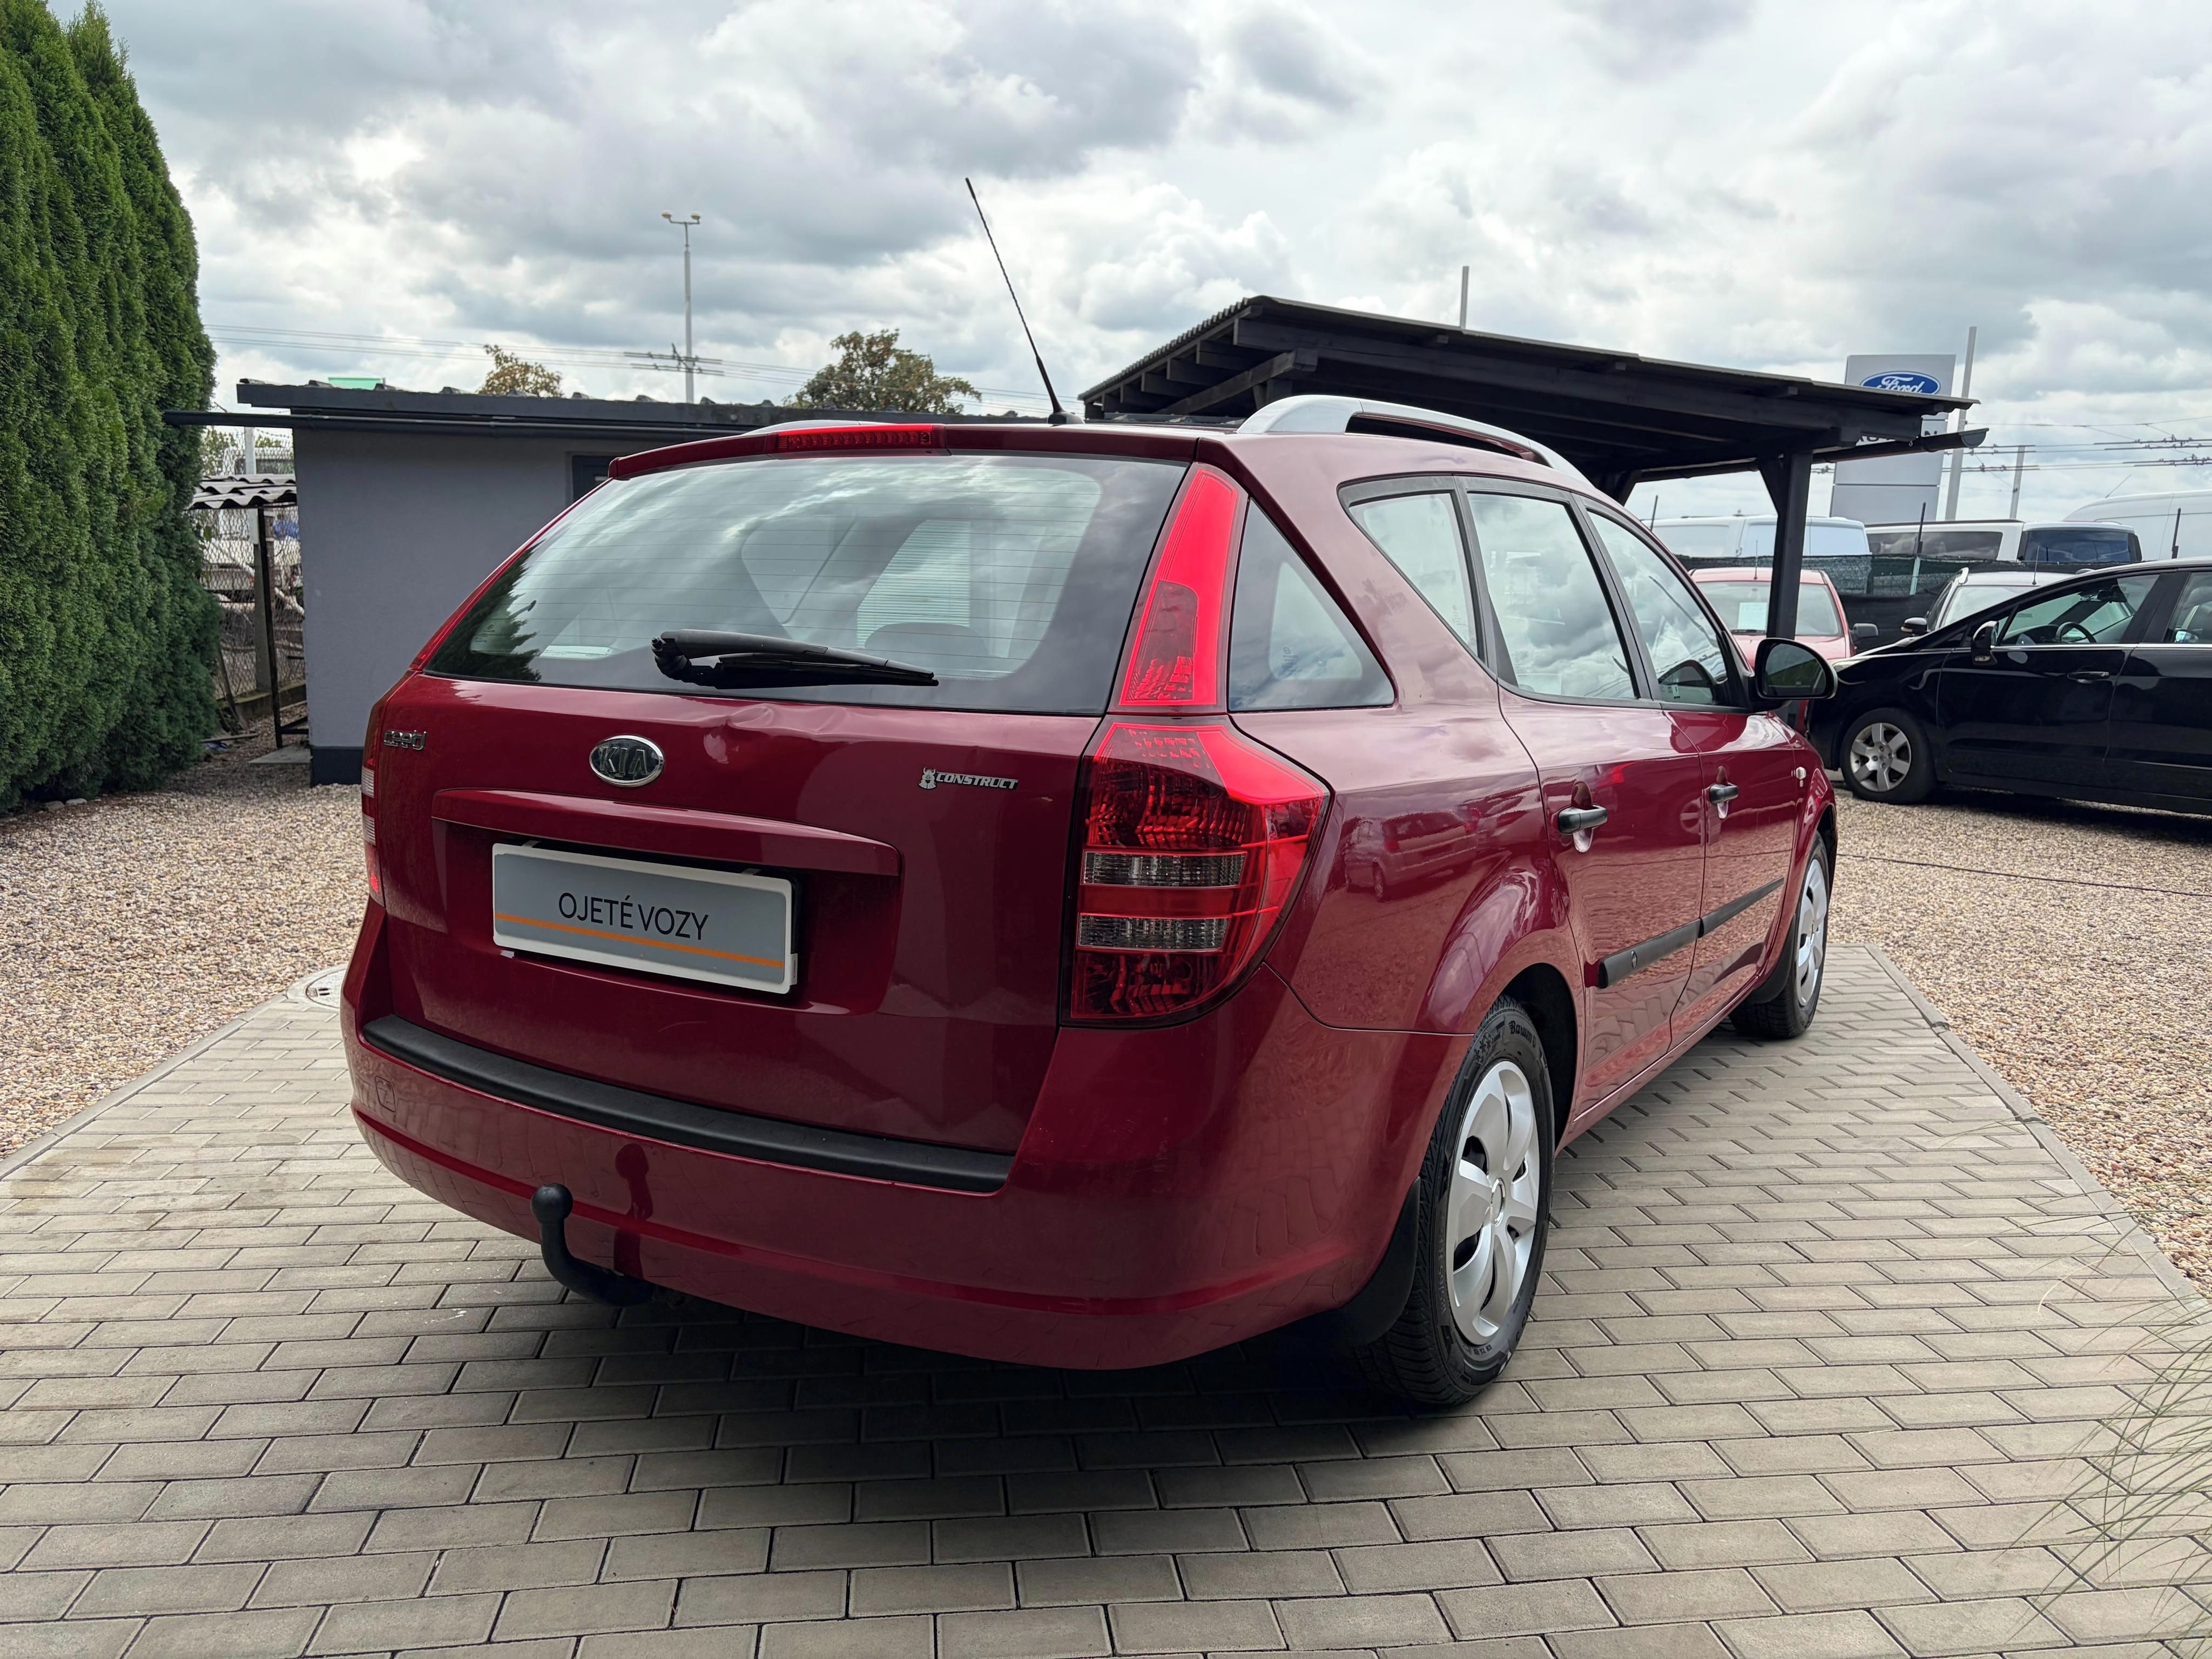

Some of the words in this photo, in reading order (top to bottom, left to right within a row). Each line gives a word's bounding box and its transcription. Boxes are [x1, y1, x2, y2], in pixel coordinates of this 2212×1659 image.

[1877, 375, 1925, 393] Ford
[599, 745, 648, 776] KIA
[936, 771, 1019, 789] CONSTRUCT
[558, 892, 633, 929] OJETÉ
[638, 904, 709, 940] VOZY
